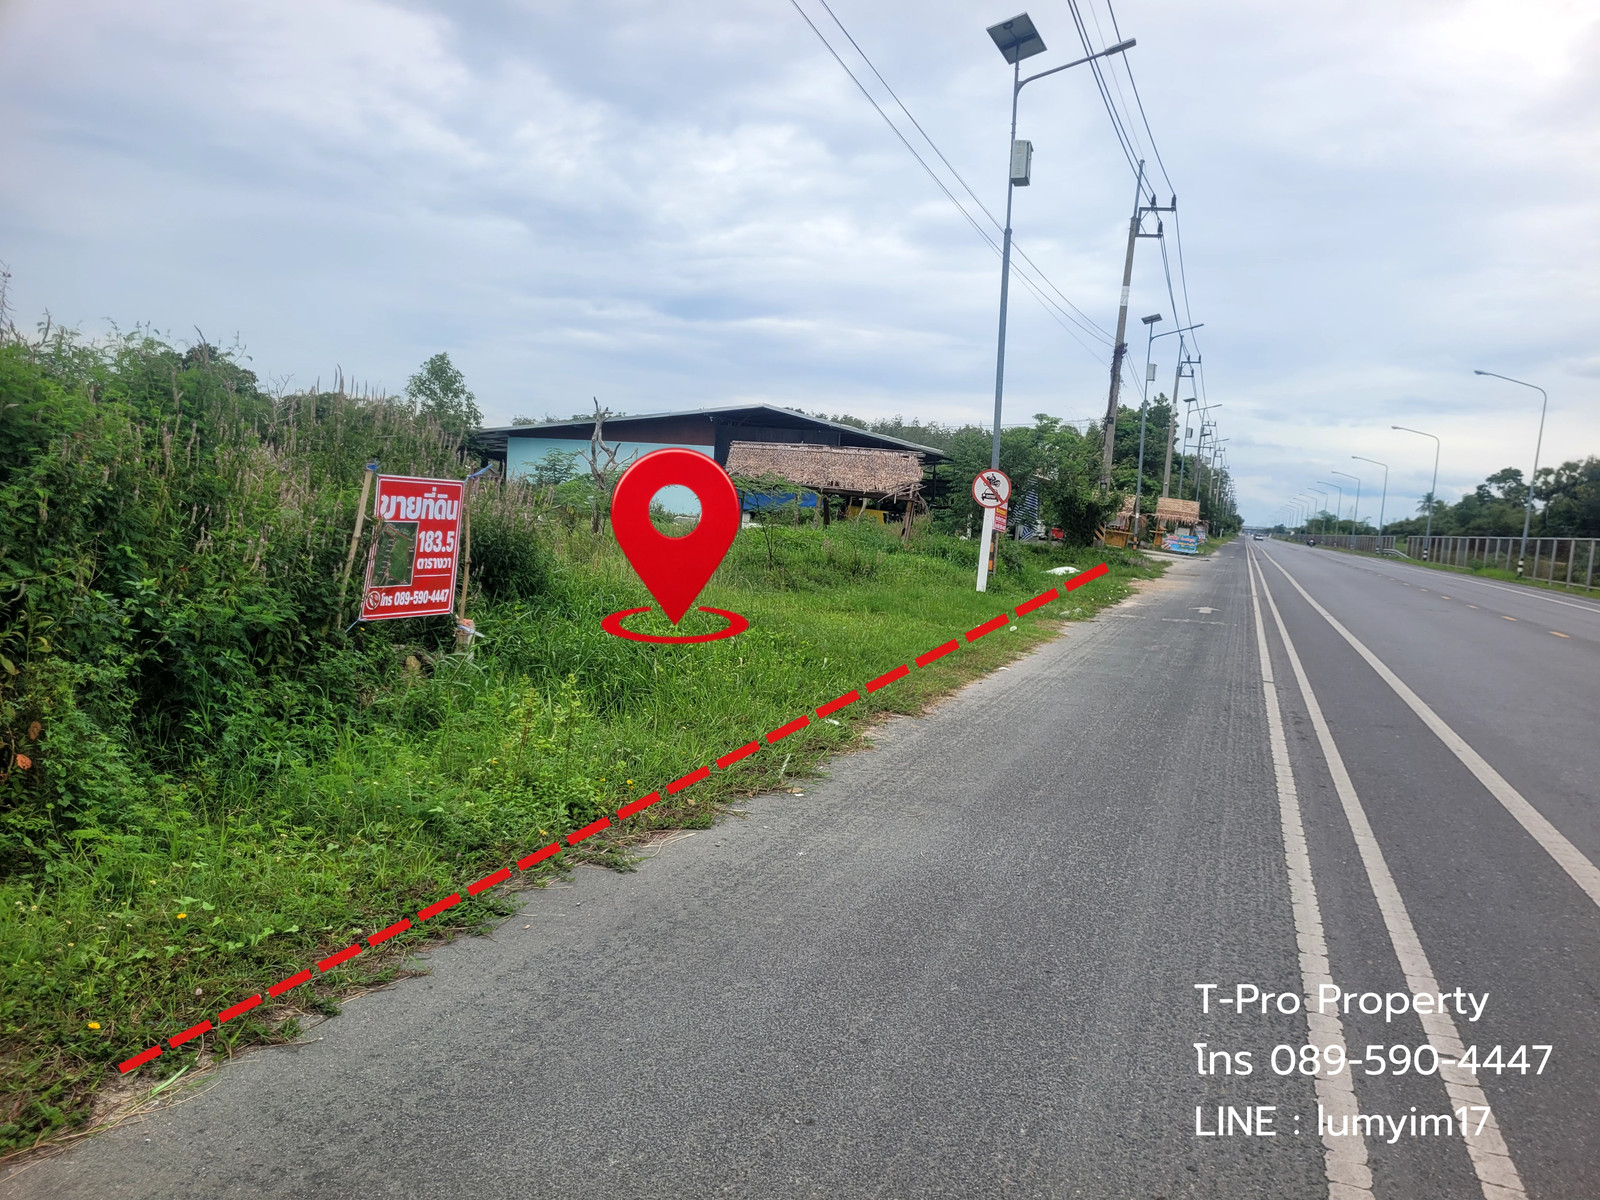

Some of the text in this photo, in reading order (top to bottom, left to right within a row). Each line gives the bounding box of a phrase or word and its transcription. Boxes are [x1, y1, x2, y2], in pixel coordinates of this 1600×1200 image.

[380, 487, 458, 520] ขายที่ดิน
[419, 531, 455, 552] 183.5
[417, 558, 451, 569] ตารางวา
[380, 589, 449, 606] โทร 089-590-4447
